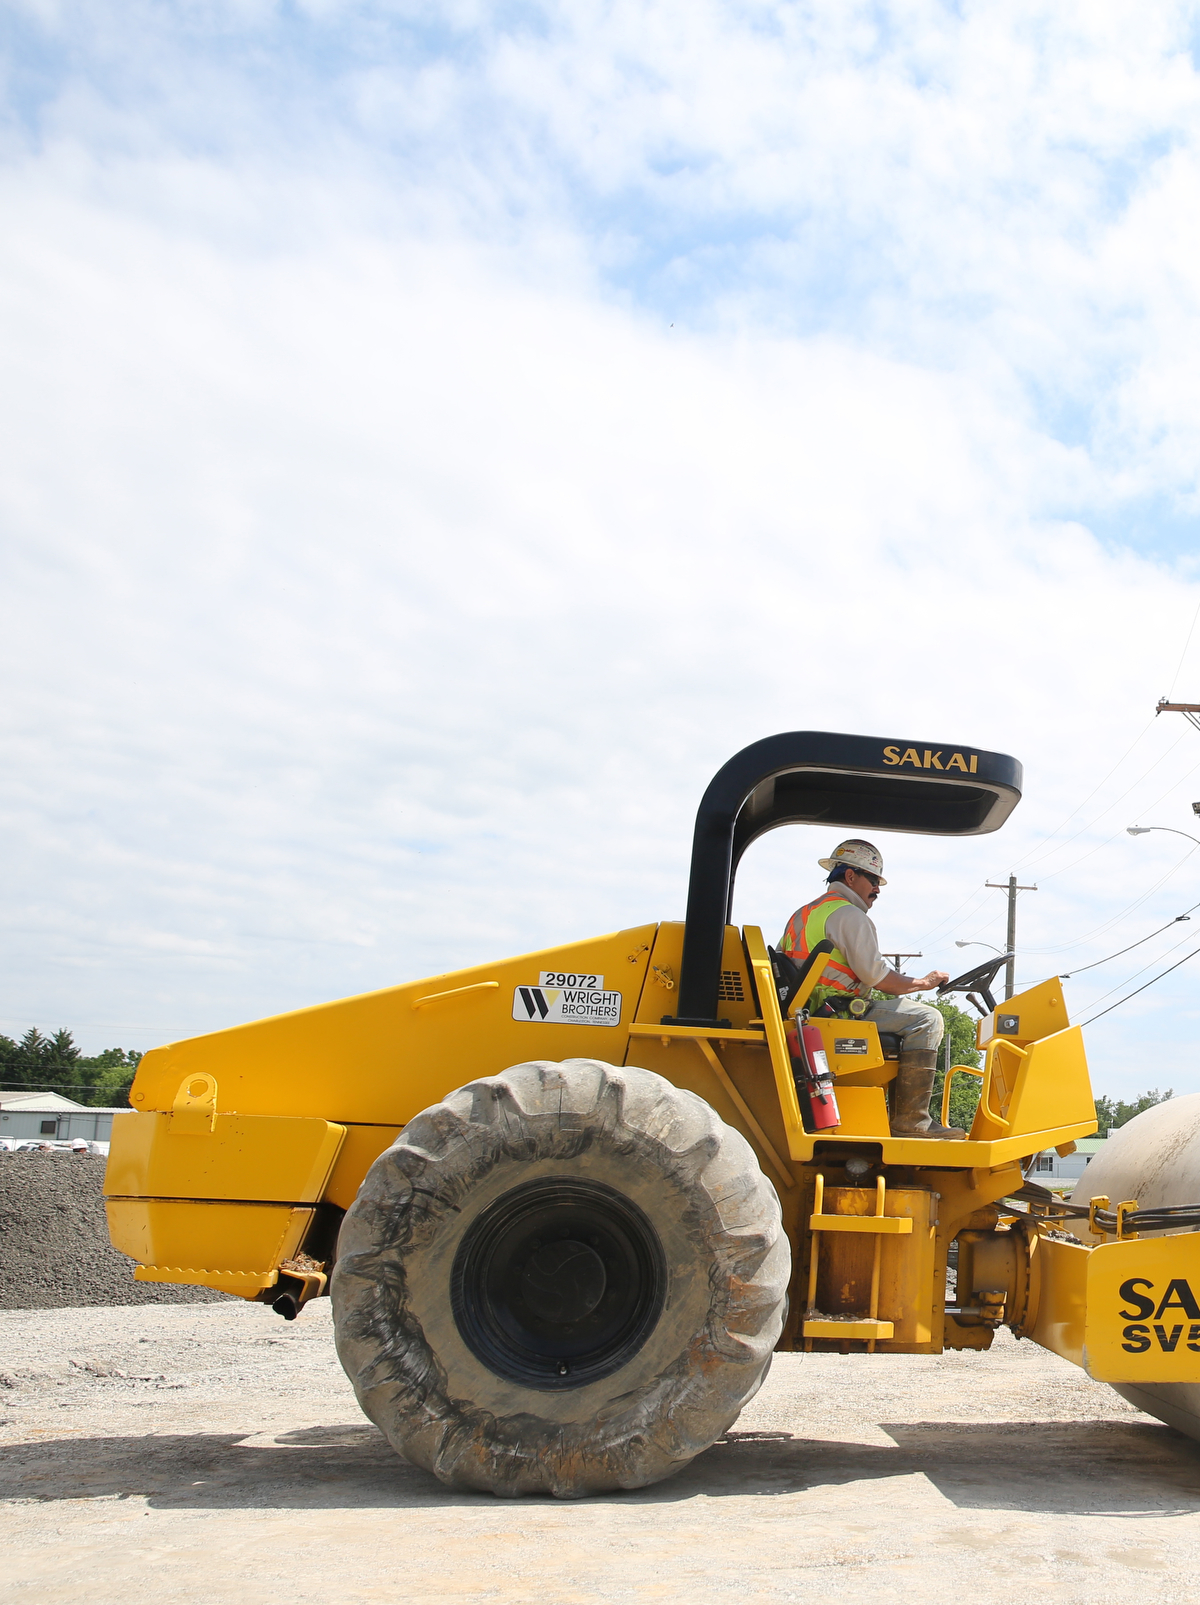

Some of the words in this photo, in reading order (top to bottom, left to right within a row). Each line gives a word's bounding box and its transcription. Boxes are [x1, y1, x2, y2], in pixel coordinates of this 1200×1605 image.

[882, 745, 978, 774] SAKAI
[545, 973, 597, 988] 29072
[563, 990, 619, 1006] WRIGHT
[561, 1004, 618, 1017] BROTHERS
